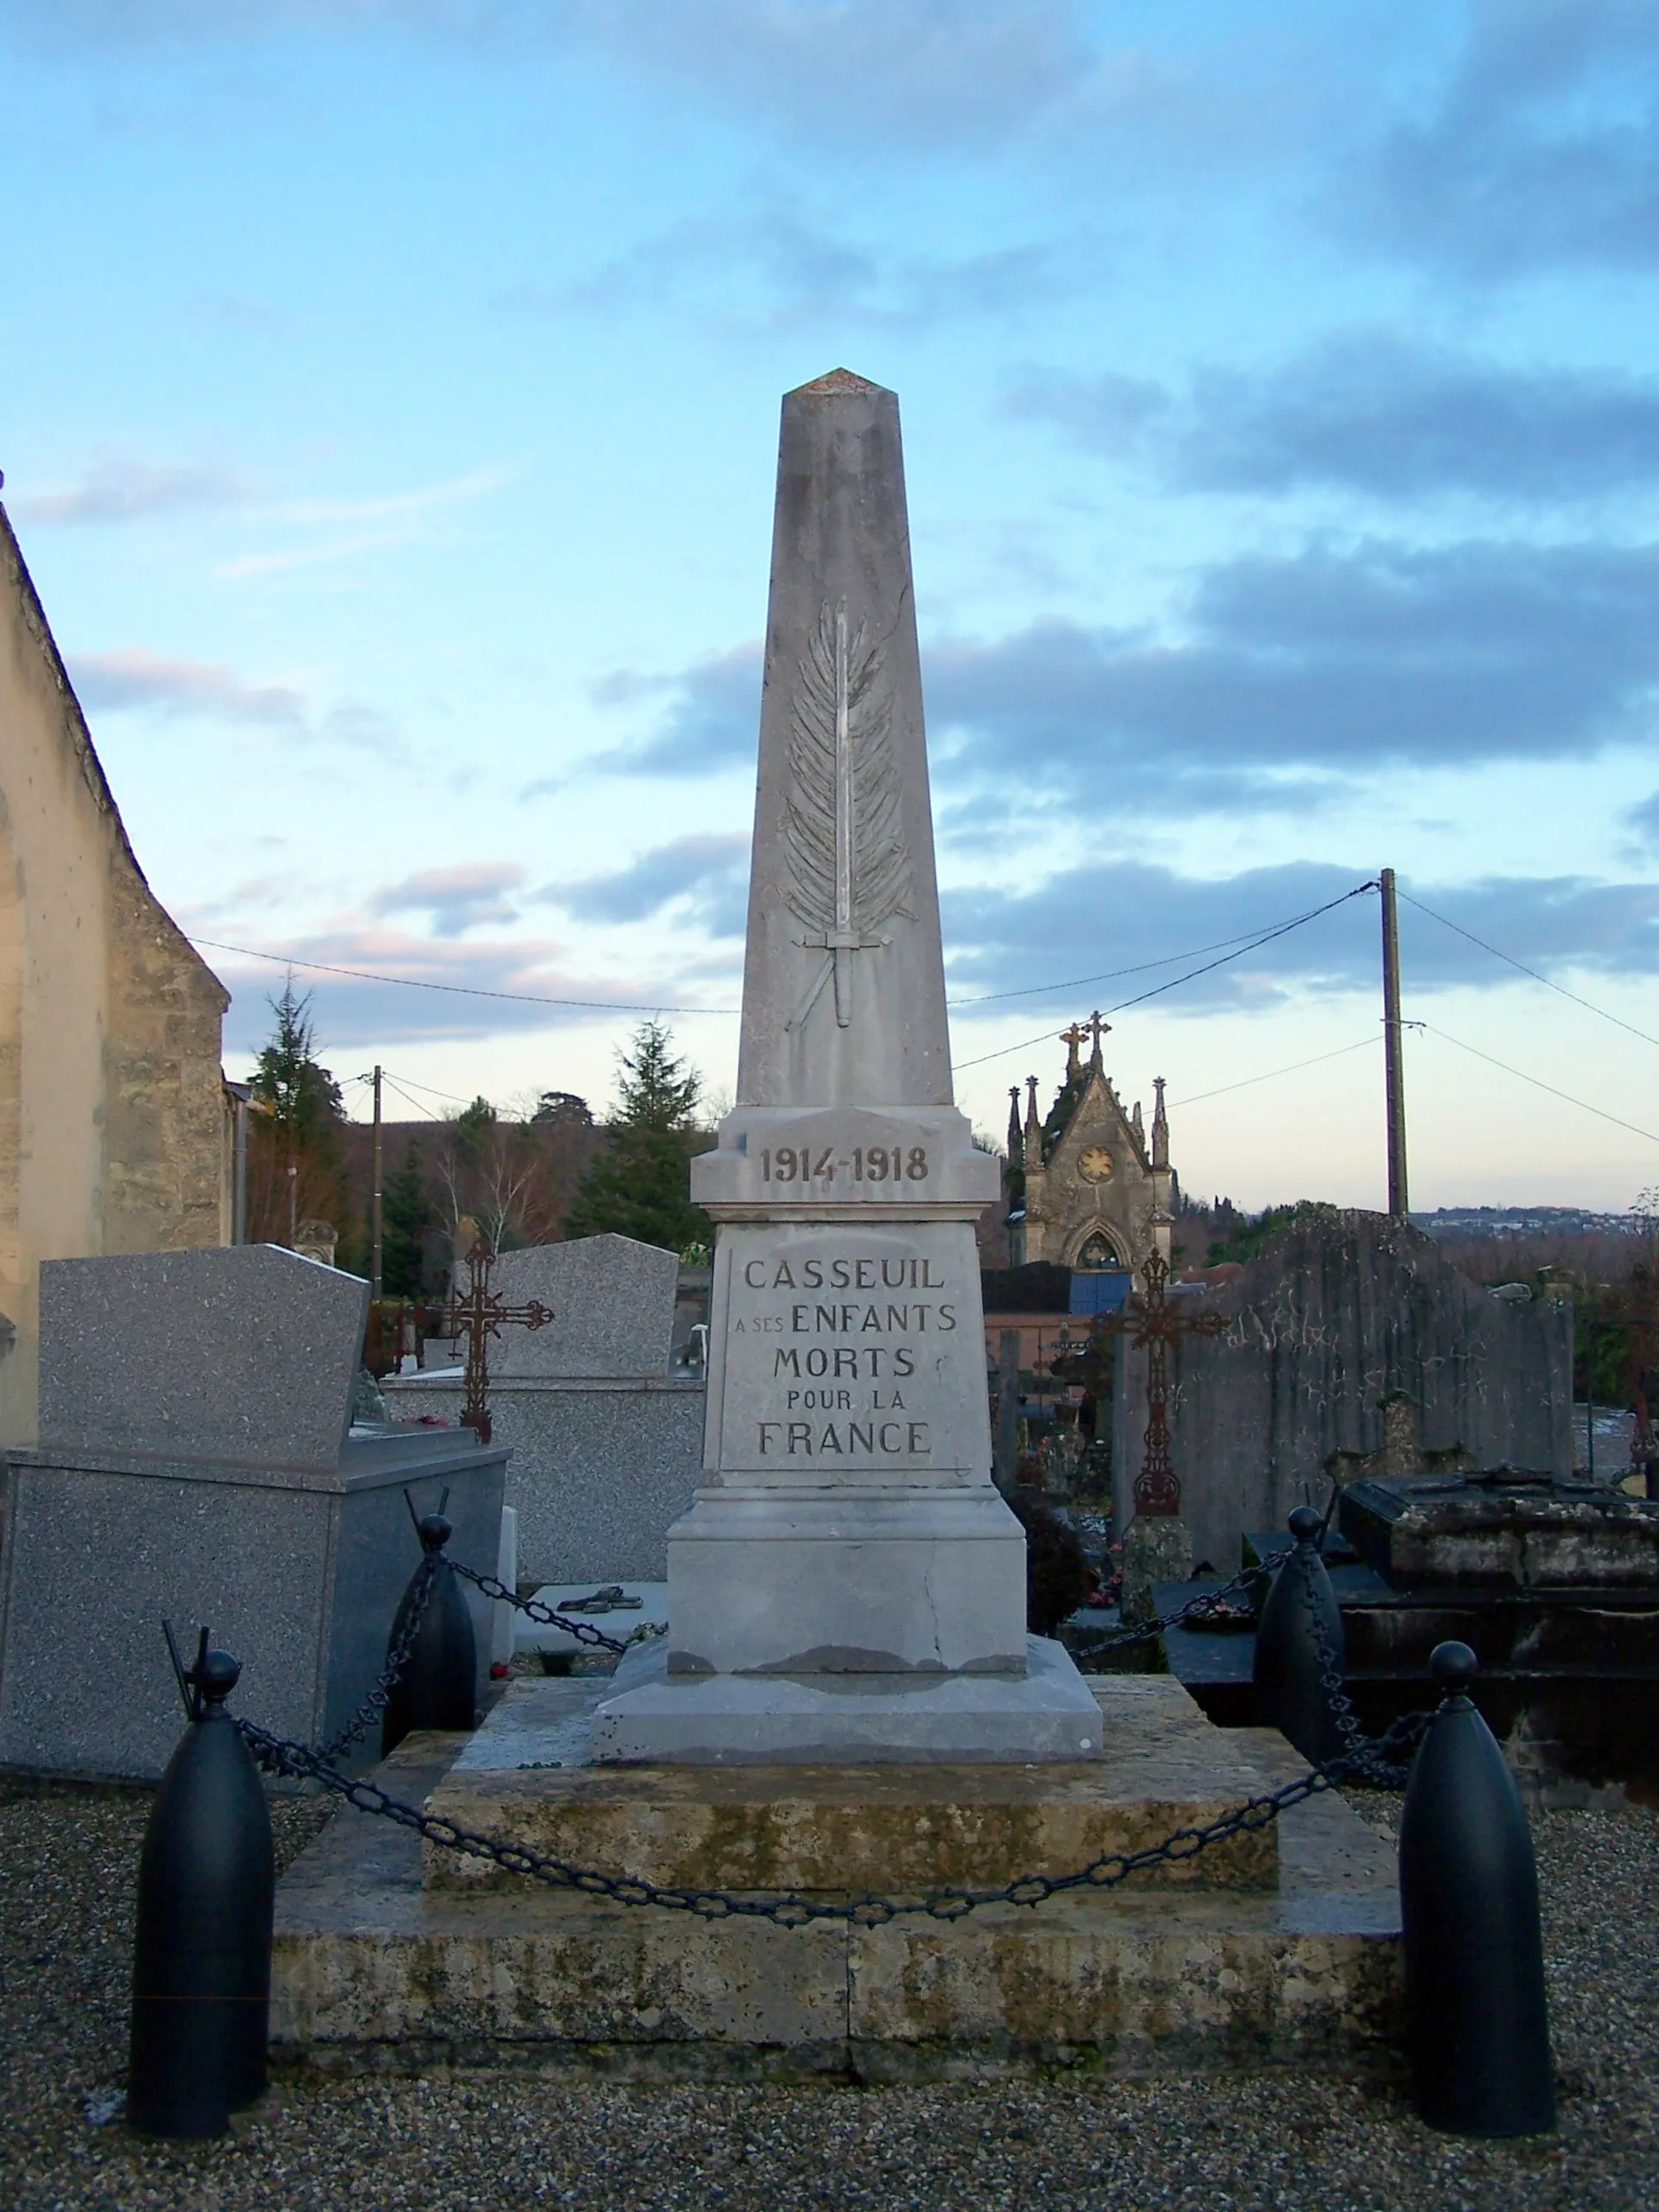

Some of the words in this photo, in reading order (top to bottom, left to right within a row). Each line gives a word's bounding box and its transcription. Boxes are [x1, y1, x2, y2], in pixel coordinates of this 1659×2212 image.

[760, 1146, 929, 1182] 1914-1918
[744, 1259, 945, 1290] CASSEUIL
[752, 1317, 783, 1333] SES
[791, 1304, 957, 1333] ENFANTS
[774, 1347, 915, 1380] MORTS
[787, 1389, 851, 1410] POUR
[872, 1389, 907, 1410] LA
[757, 1422, 932, 1455] FRANCE
